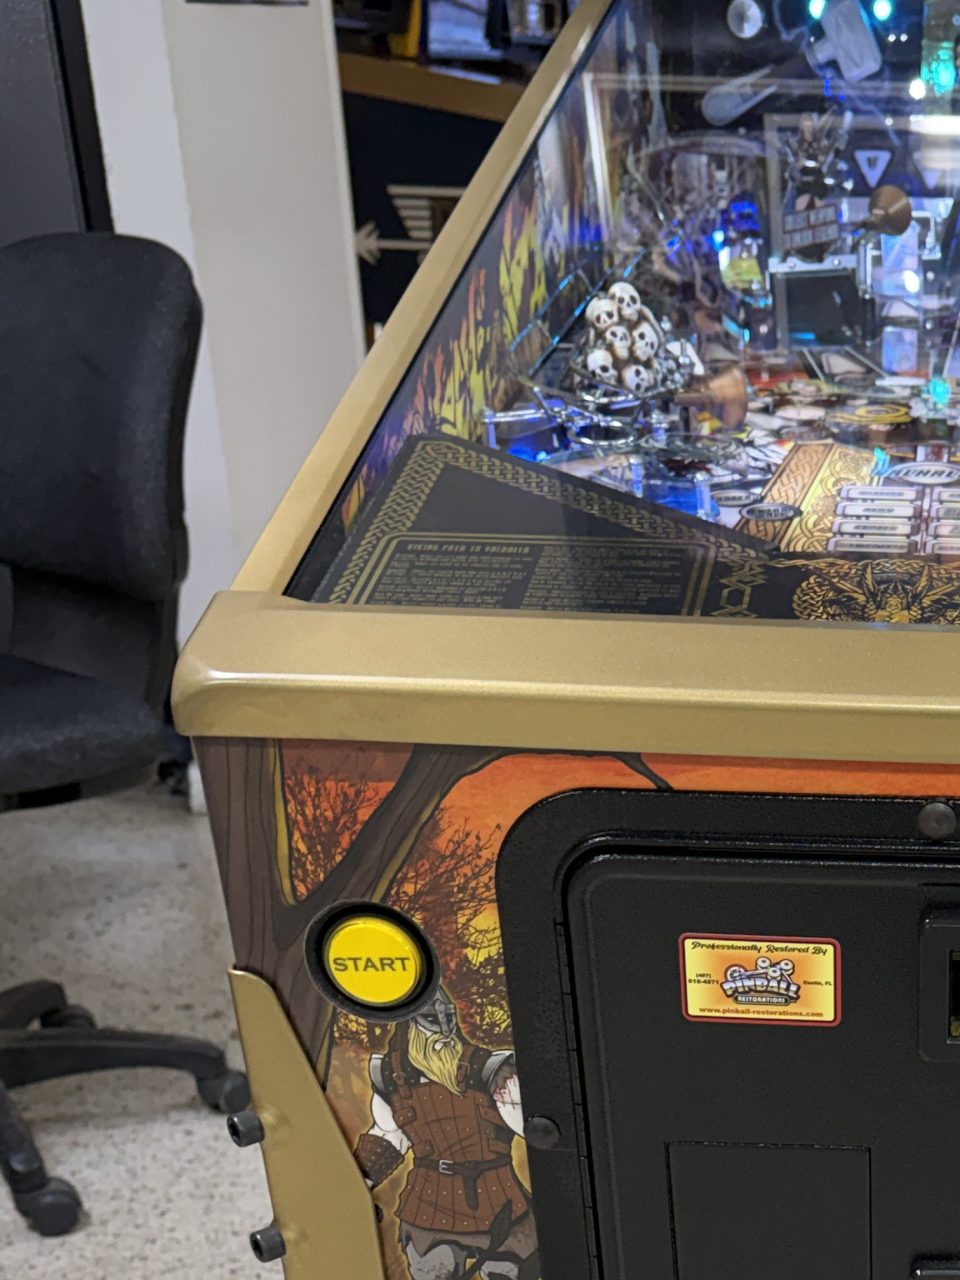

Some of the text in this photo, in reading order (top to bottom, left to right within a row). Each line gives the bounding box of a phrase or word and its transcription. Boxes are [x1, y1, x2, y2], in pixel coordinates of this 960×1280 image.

[691, 941, 828, 956] Professionally Restored By
[333, 957, 410, 972] START
[721, 975, 800, 999] PINBALL
[737, 995, 786, 1004] RESTORATIONS
[699, 1006, 824, 1018] www.pinball-restorations.com
